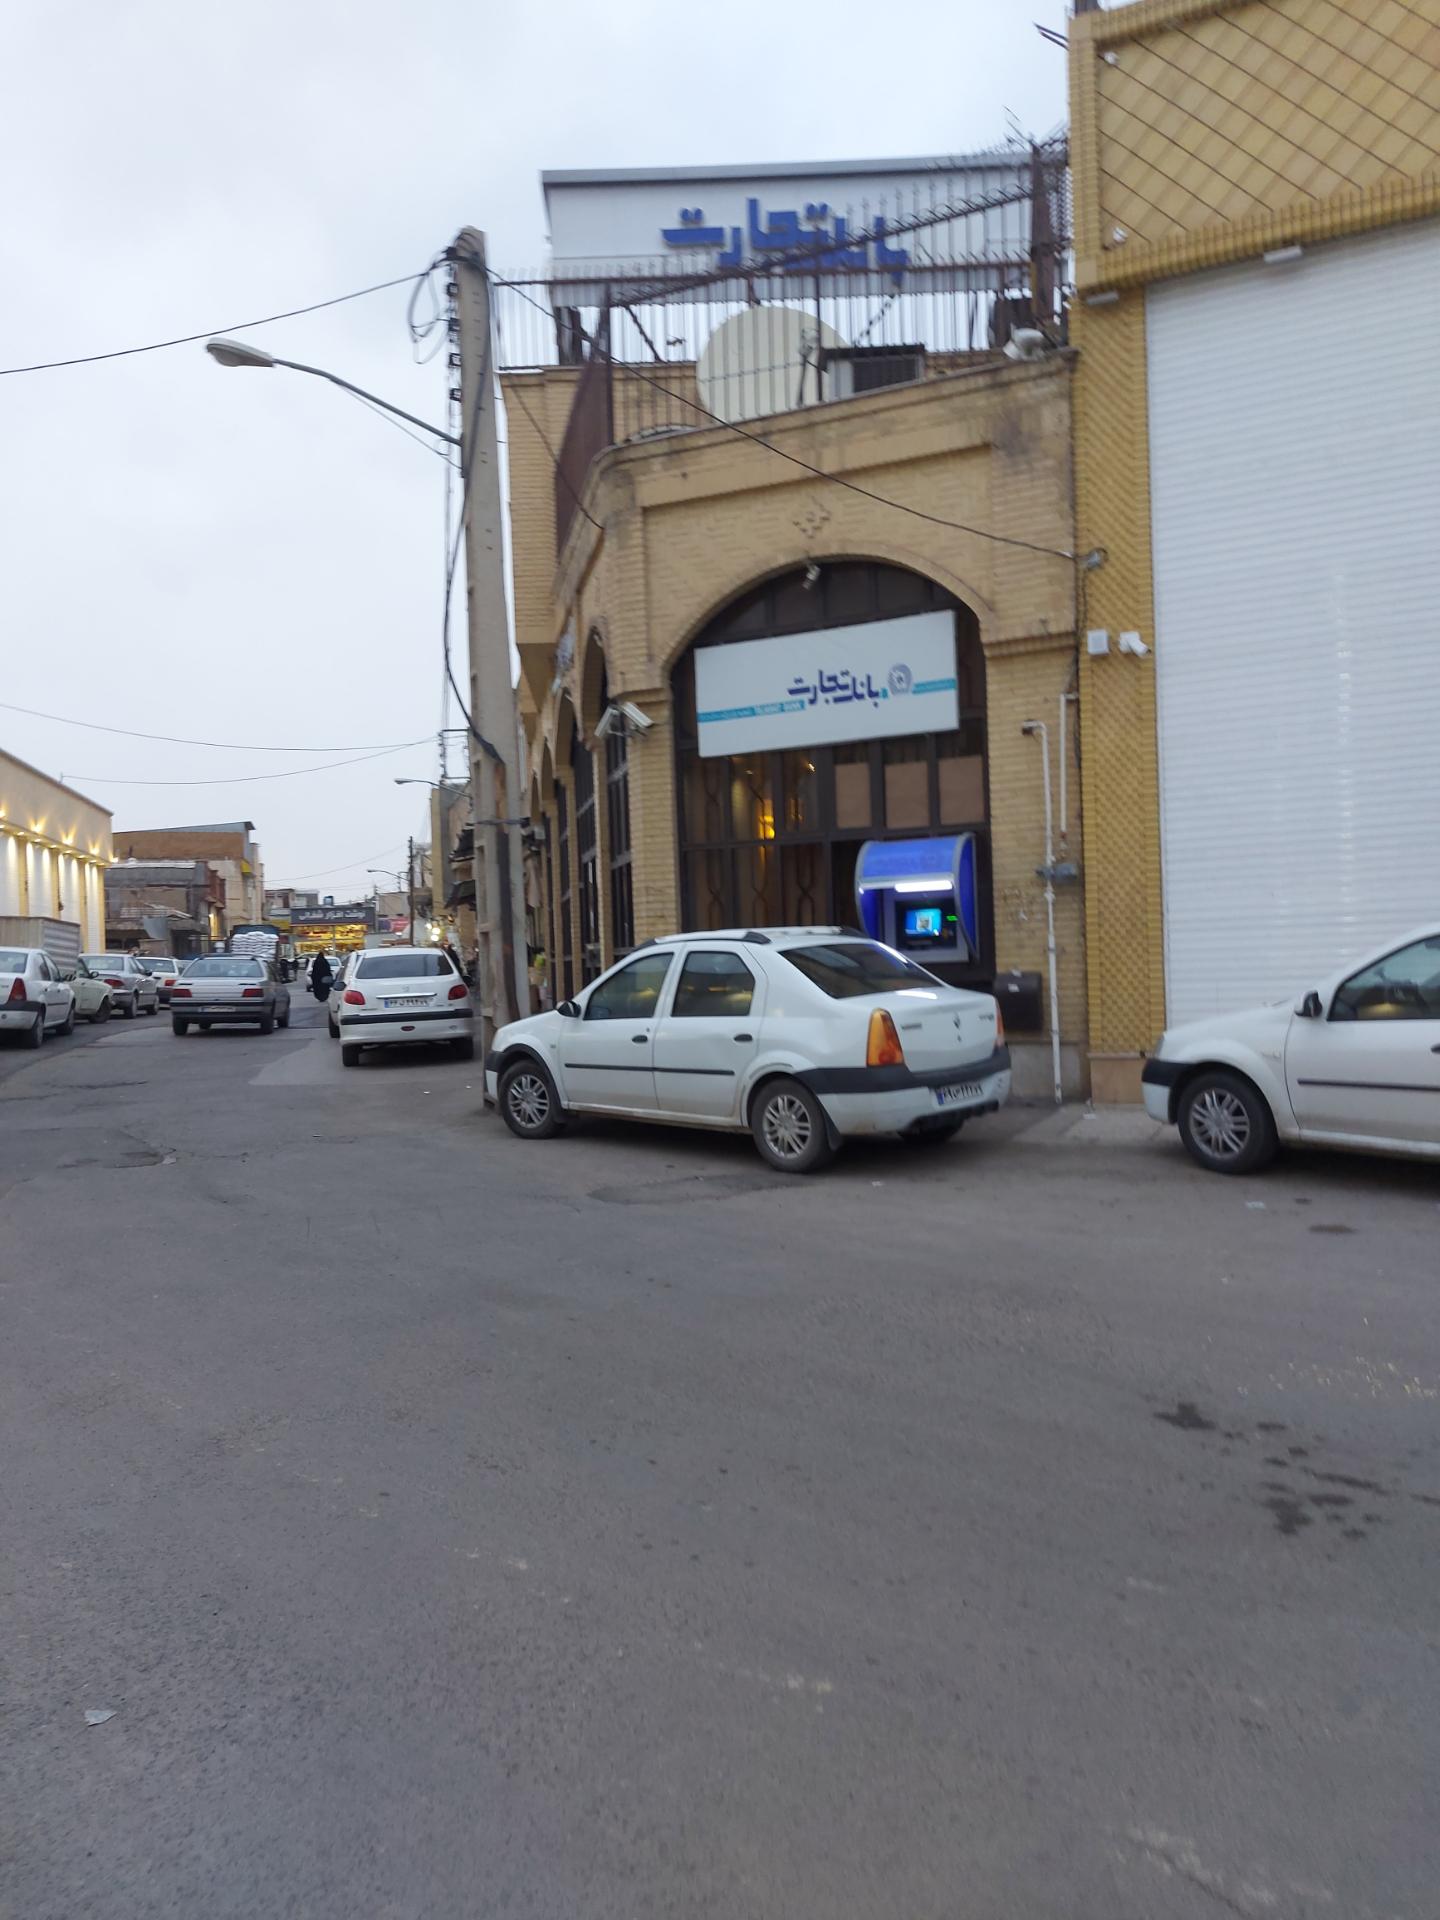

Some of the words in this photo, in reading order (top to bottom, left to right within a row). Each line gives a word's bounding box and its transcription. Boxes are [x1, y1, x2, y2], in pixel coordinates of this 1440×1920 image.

[661, 197, 830, 270] تجارت
[786, 668, 850, 706] تجارت
[833, 673, 880, 709] بانک
